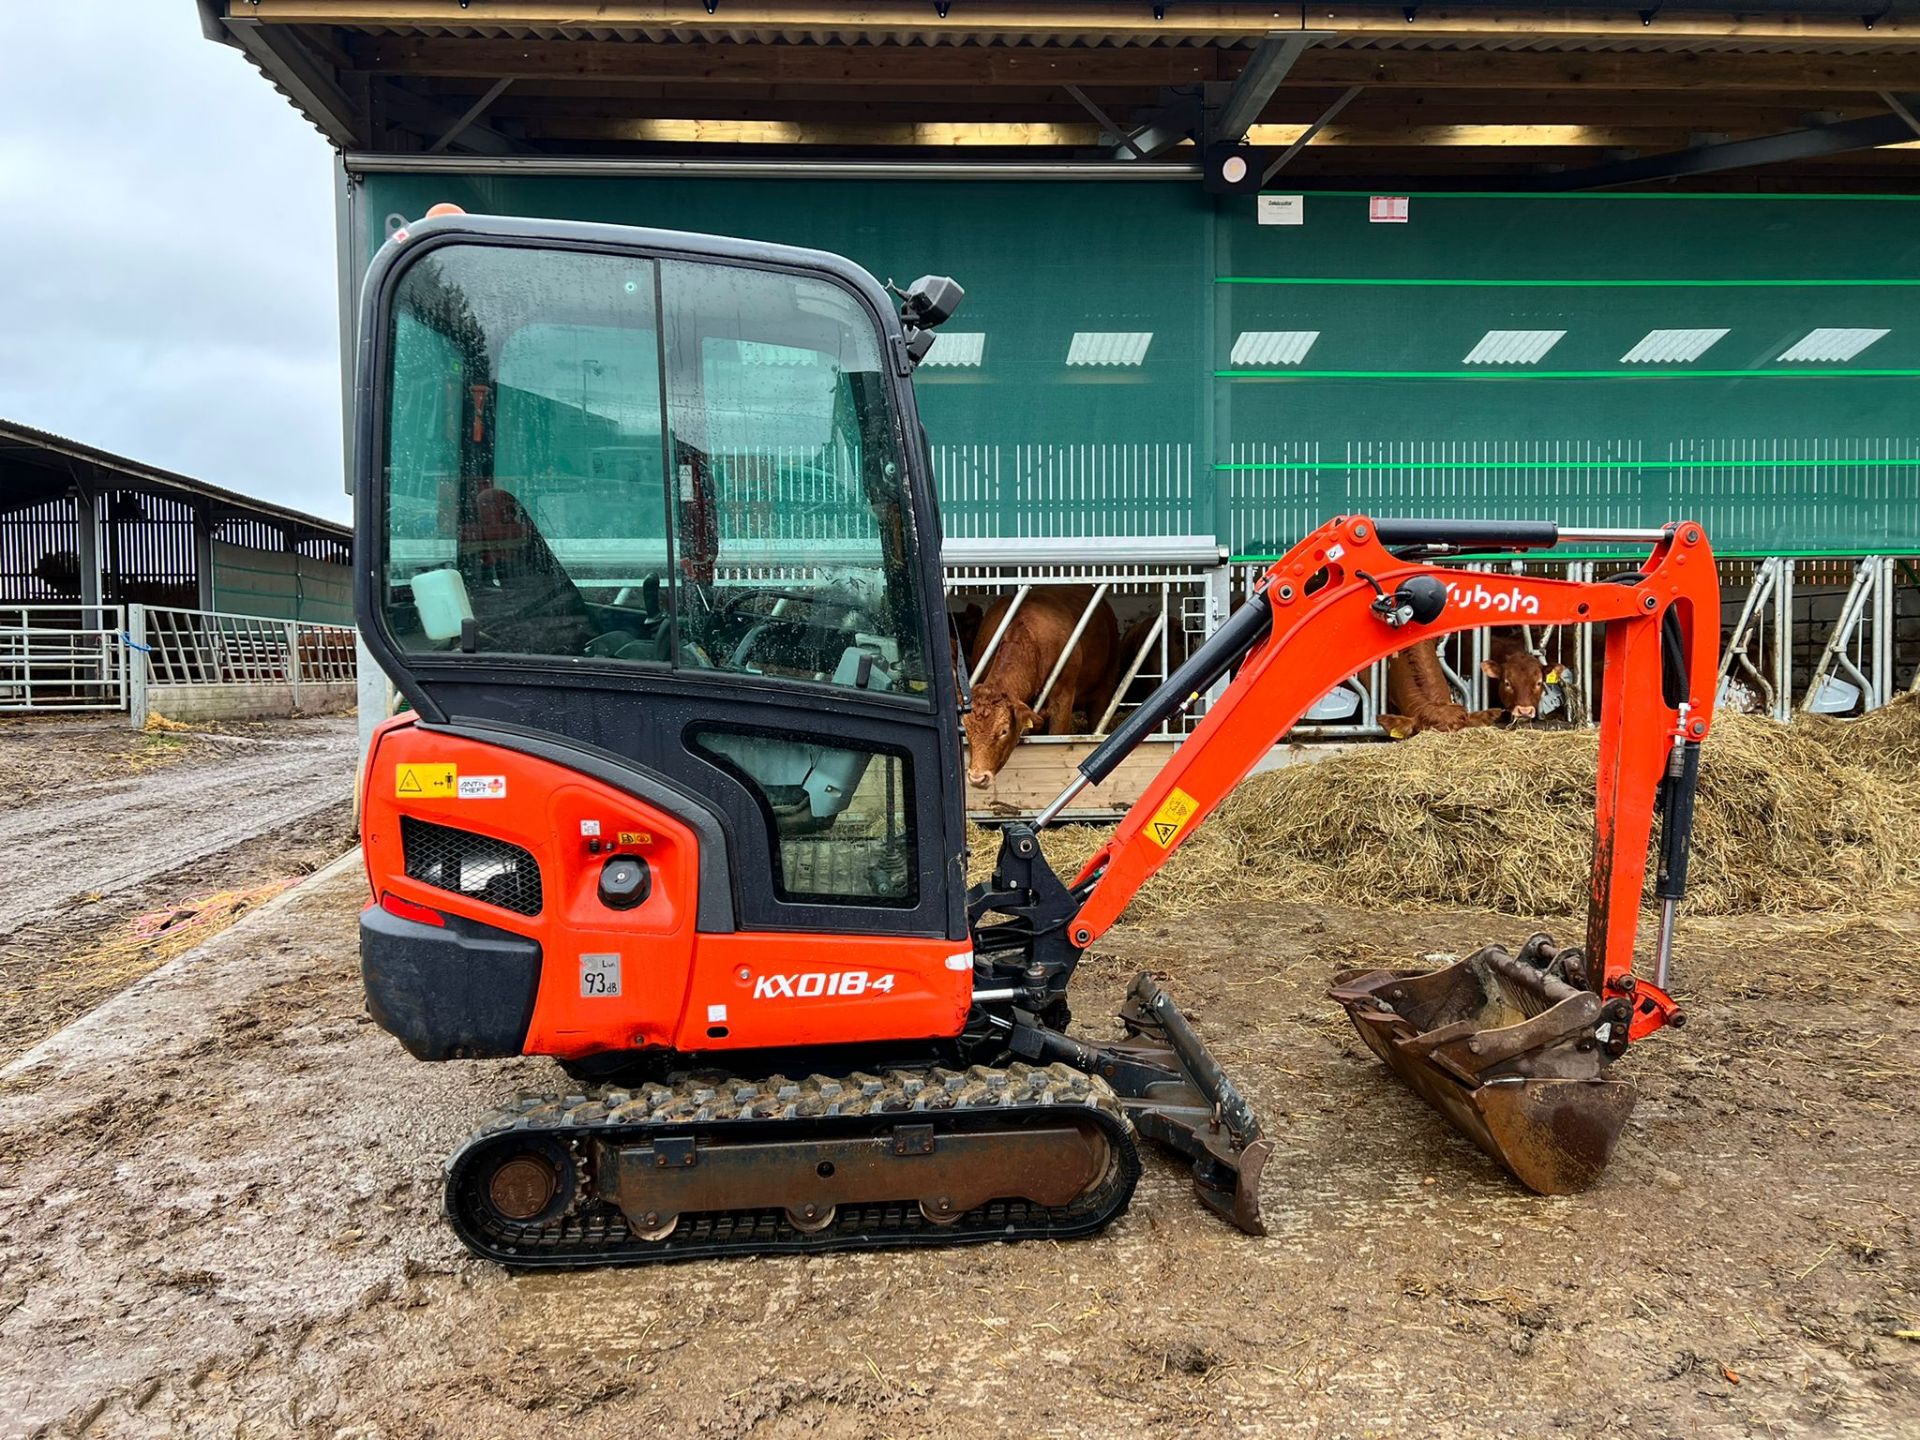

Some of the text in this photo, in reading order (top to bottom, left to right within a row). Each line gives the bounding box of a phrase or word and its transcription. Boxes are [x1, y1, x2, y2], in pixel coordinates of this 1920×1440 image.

[584, 972, 618, 994] 93 dB
[753, 971, 895, 999] KX018-4
